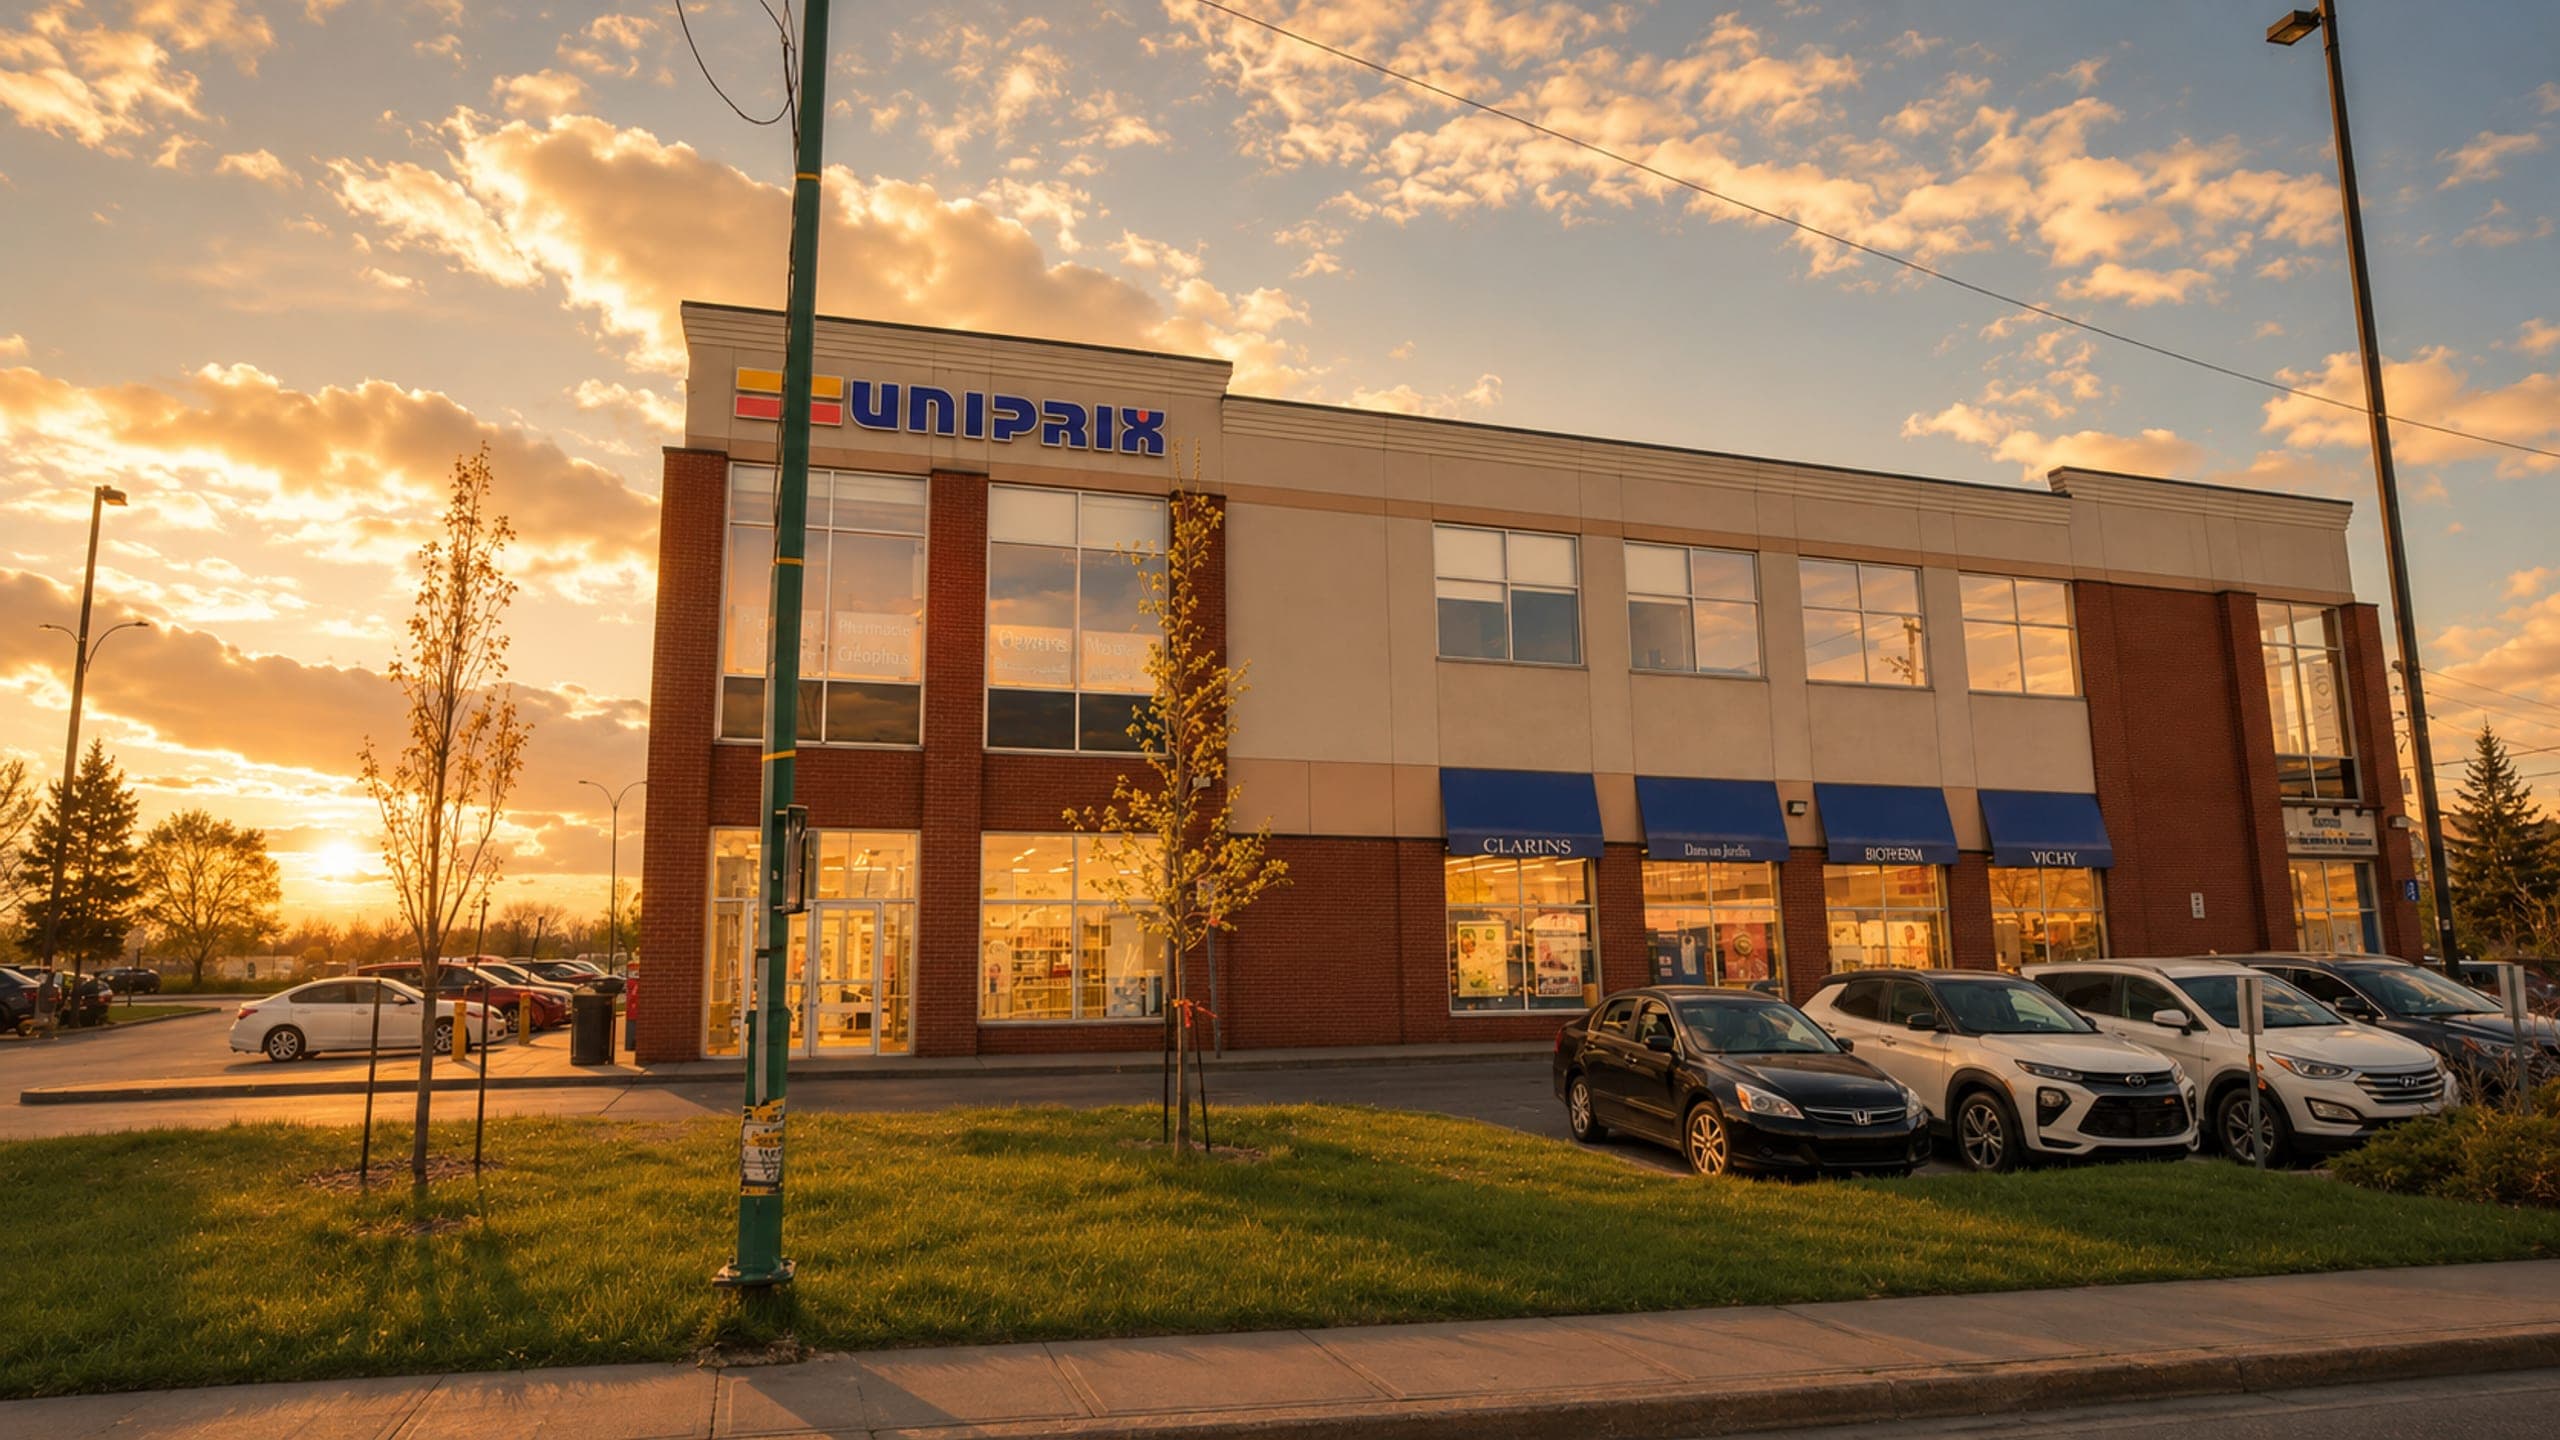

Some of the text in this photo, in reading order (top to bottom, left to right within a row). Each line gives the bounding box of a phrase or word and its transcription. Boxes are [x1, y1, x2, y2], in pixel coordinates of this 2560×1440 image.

[849, 379, 1167, 457] UNIPRIX
[1483, 837, 1572, 855] CLARINS
[2031, 851, 2077, 866] VICHY
